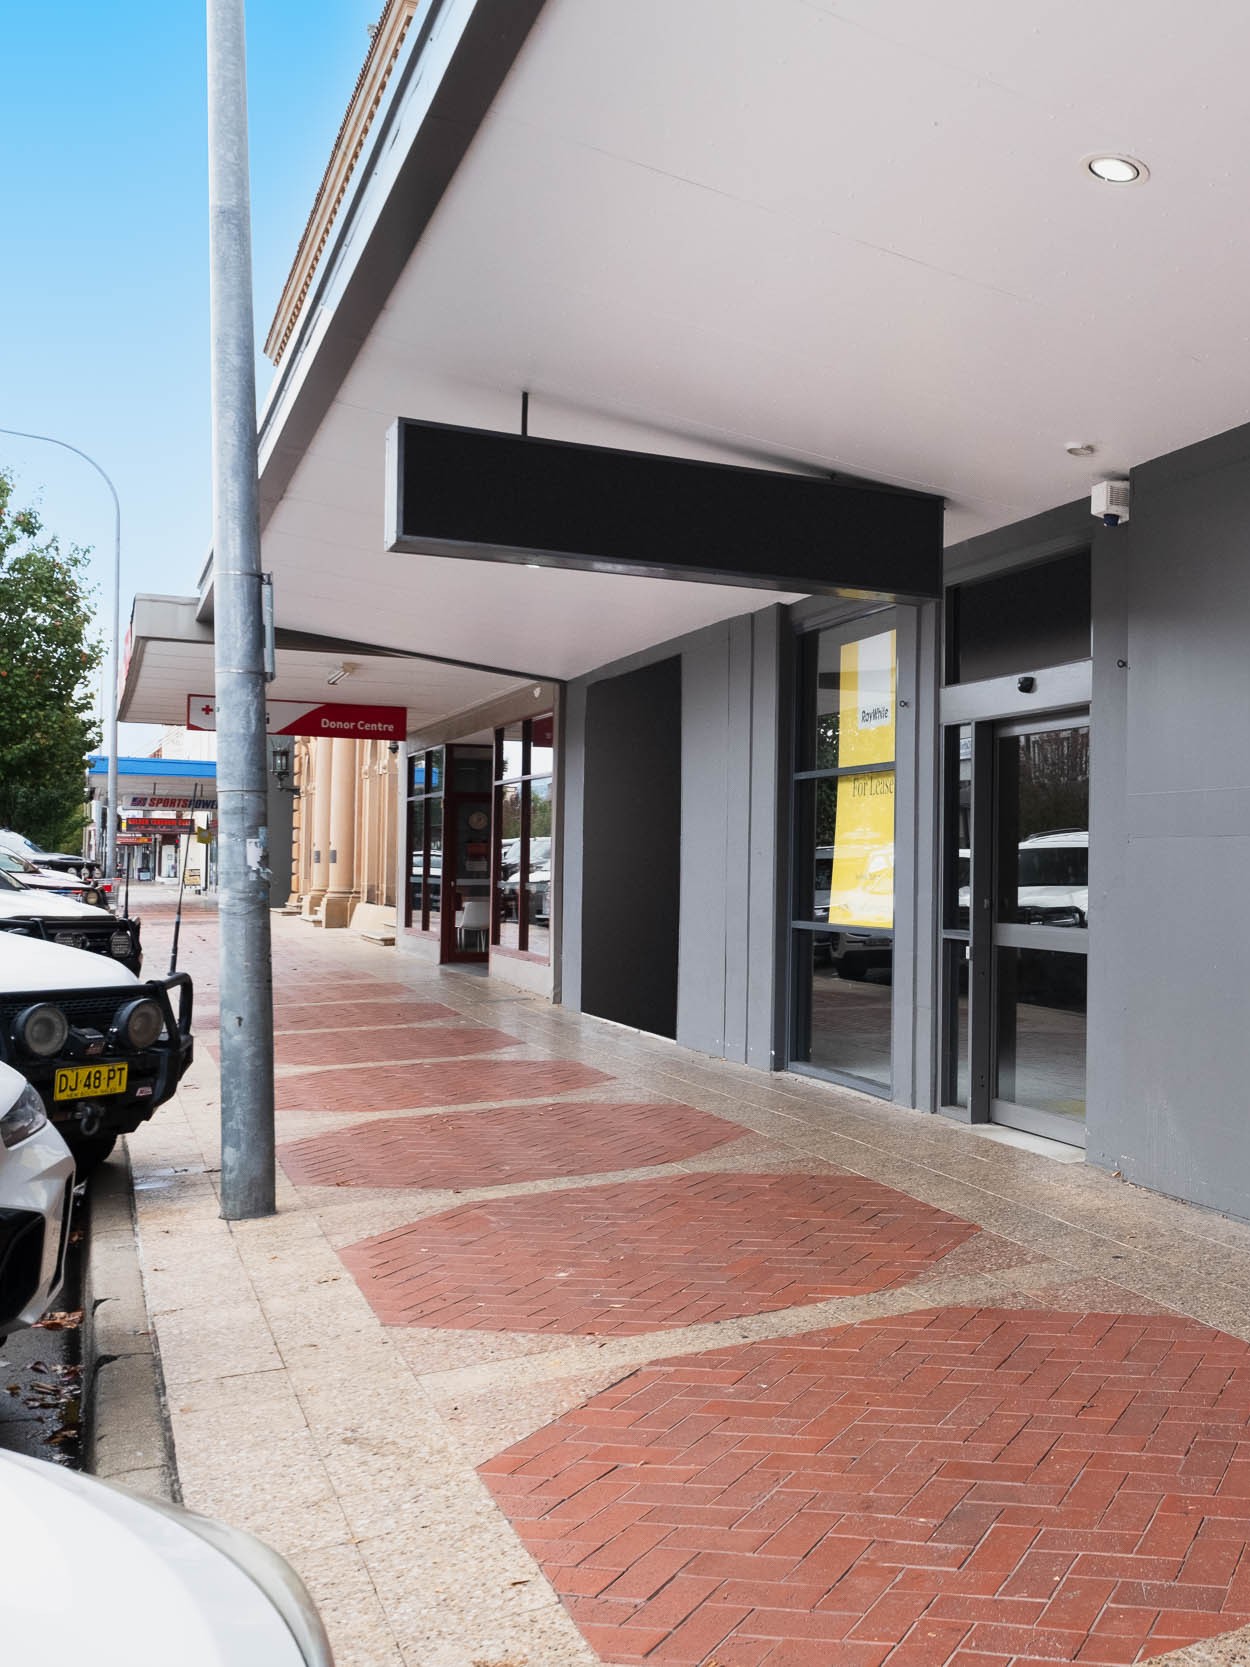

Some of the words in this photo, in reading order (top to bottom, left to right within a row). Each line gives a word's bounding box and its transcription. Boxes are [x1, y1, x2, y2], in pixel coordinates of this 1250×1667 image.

[320, 718, 355, 730] Donor
[357, 720, 394, 732] Centre
[852, 777, 868, 798] For
[869, 775, 893, 796] Lease
[148, 797, 217, 809] SPORTSPOWE
